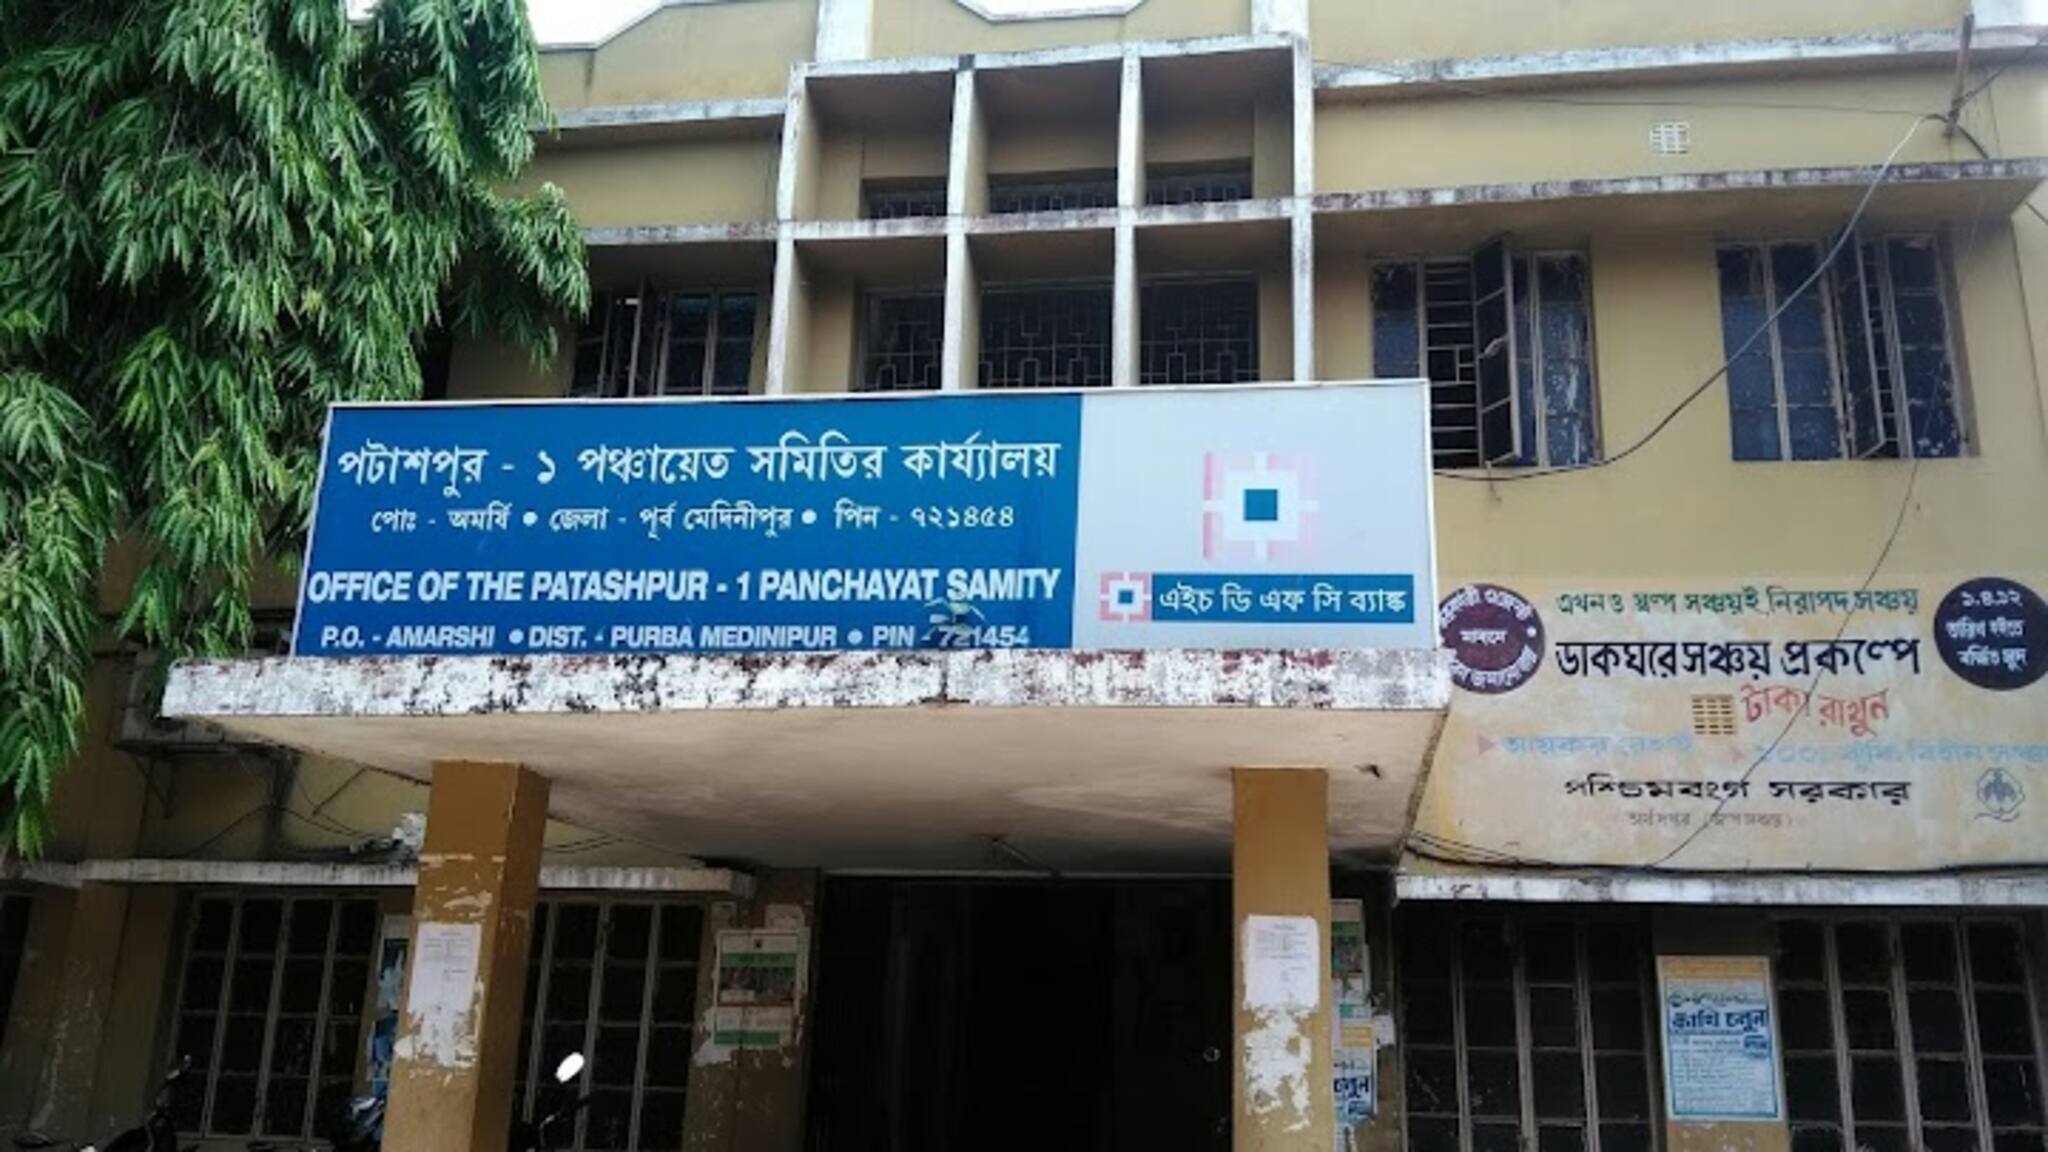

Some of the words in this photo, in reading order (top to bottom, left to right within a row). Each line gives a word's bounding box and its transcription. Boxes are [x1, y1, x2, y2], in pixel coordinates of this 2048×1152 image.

[338, 438, 489, 498] পটাশপুর
[537, 450, 556, 484] ১
[577, 443, 735, 484] পঞ্চায়েত
[745, 431, 888, 482] সমিতির
[900, 431, 1062, 481] কার্য্যালয়
[371, 508, 417, 532] পোঃ
[549, 506, 609, 532] জেলা
[639, 501, 677, 540] পূর্ব
[683, 499, 794, 538] মেদিনীপুর
[835, 497, 881, 530] পিন
[910, 506, 1014, 530] ৭২১৪৫৪
[307, 570, 413, 603] OFFICE
[418, 570, 460, 603] OF
[466, 570, 524, 602] THE
[530, 569, 709, 602] PATASHPUR
[716, 583, 728, 593] -
[736, 570, 750, 601] 1
[758, 569, 940, 601] PANCHAYAT
[946, 568, 1061, 600] SAMITY
[1159, 580, 1214, 615] এইচ
[1221, 582, 1252, 613] ডি
[1260, 588, 1305, 613] এফ
[1313, 582, 1342, 613] সি
[1349, 587, 1407, 613] ব্যাঙ্ক
[1766, 586, 1849, 614] নিরাপদ
[1853, 589, 1919, 615] সঞ্চয়
[320, 625, 364, 648] P.O.
[385, 625, 495, 648] AMARSHI
[529, 625, 587, 648] DIST.
[611, 625, 693, 648] PURBA
[700, 625, 837, 648] MEDINIPUR
[872, 625, 915, 647] PIN
[1555, 642, 1677, 678] ডাকঘরে
[1681, 641, 1771, 680] সঞ্চয়
[1780, 639, 1921, 675] প্রকল্পে
[1740, 684, 1811, 723] টাকা
[1817, 687, 1890, 736] রাখুন
[1768, 780, 1912, 805] সরকার
